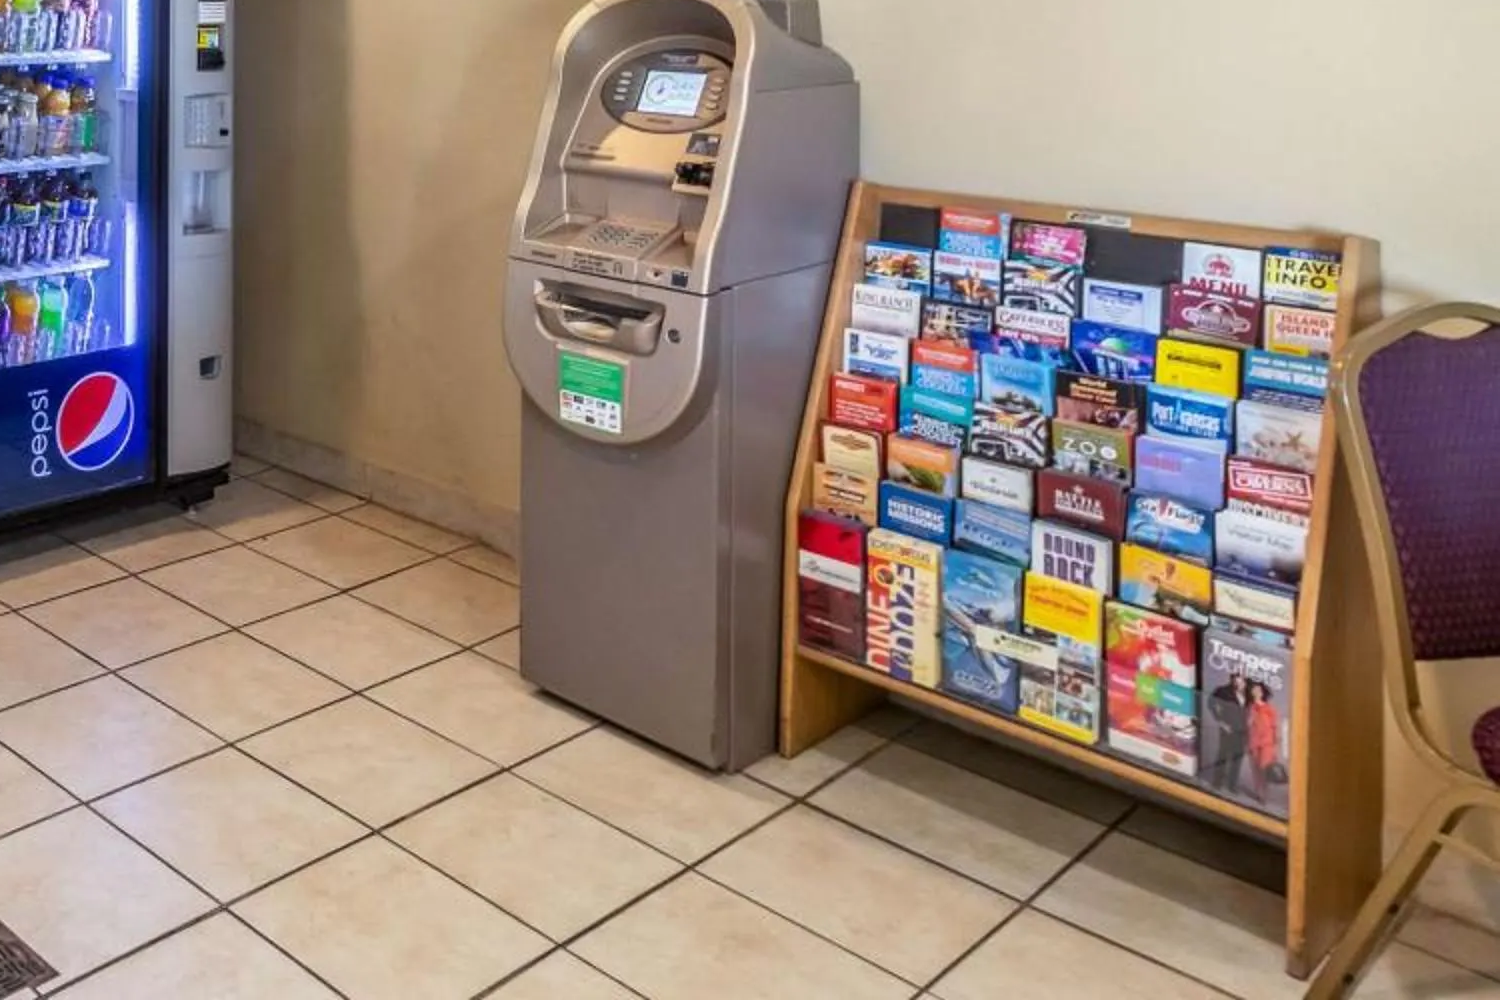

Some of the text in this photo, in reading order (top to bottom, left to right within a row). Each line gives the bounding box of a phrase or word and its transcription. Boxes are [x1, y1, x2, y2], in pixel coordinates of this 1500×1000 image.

[1189, 276, 1249, 296] MENU
[1274, 271, 1327, 289] INFO
[27, 389, 52, 478] pepsi
[1062, 436, 1118, 461] ZOO
[1043, 532, 1095, 562] ROUND
[1043, 553, 1095, 588] ROCK
[1210, 639, 1284, 674] Tanger
